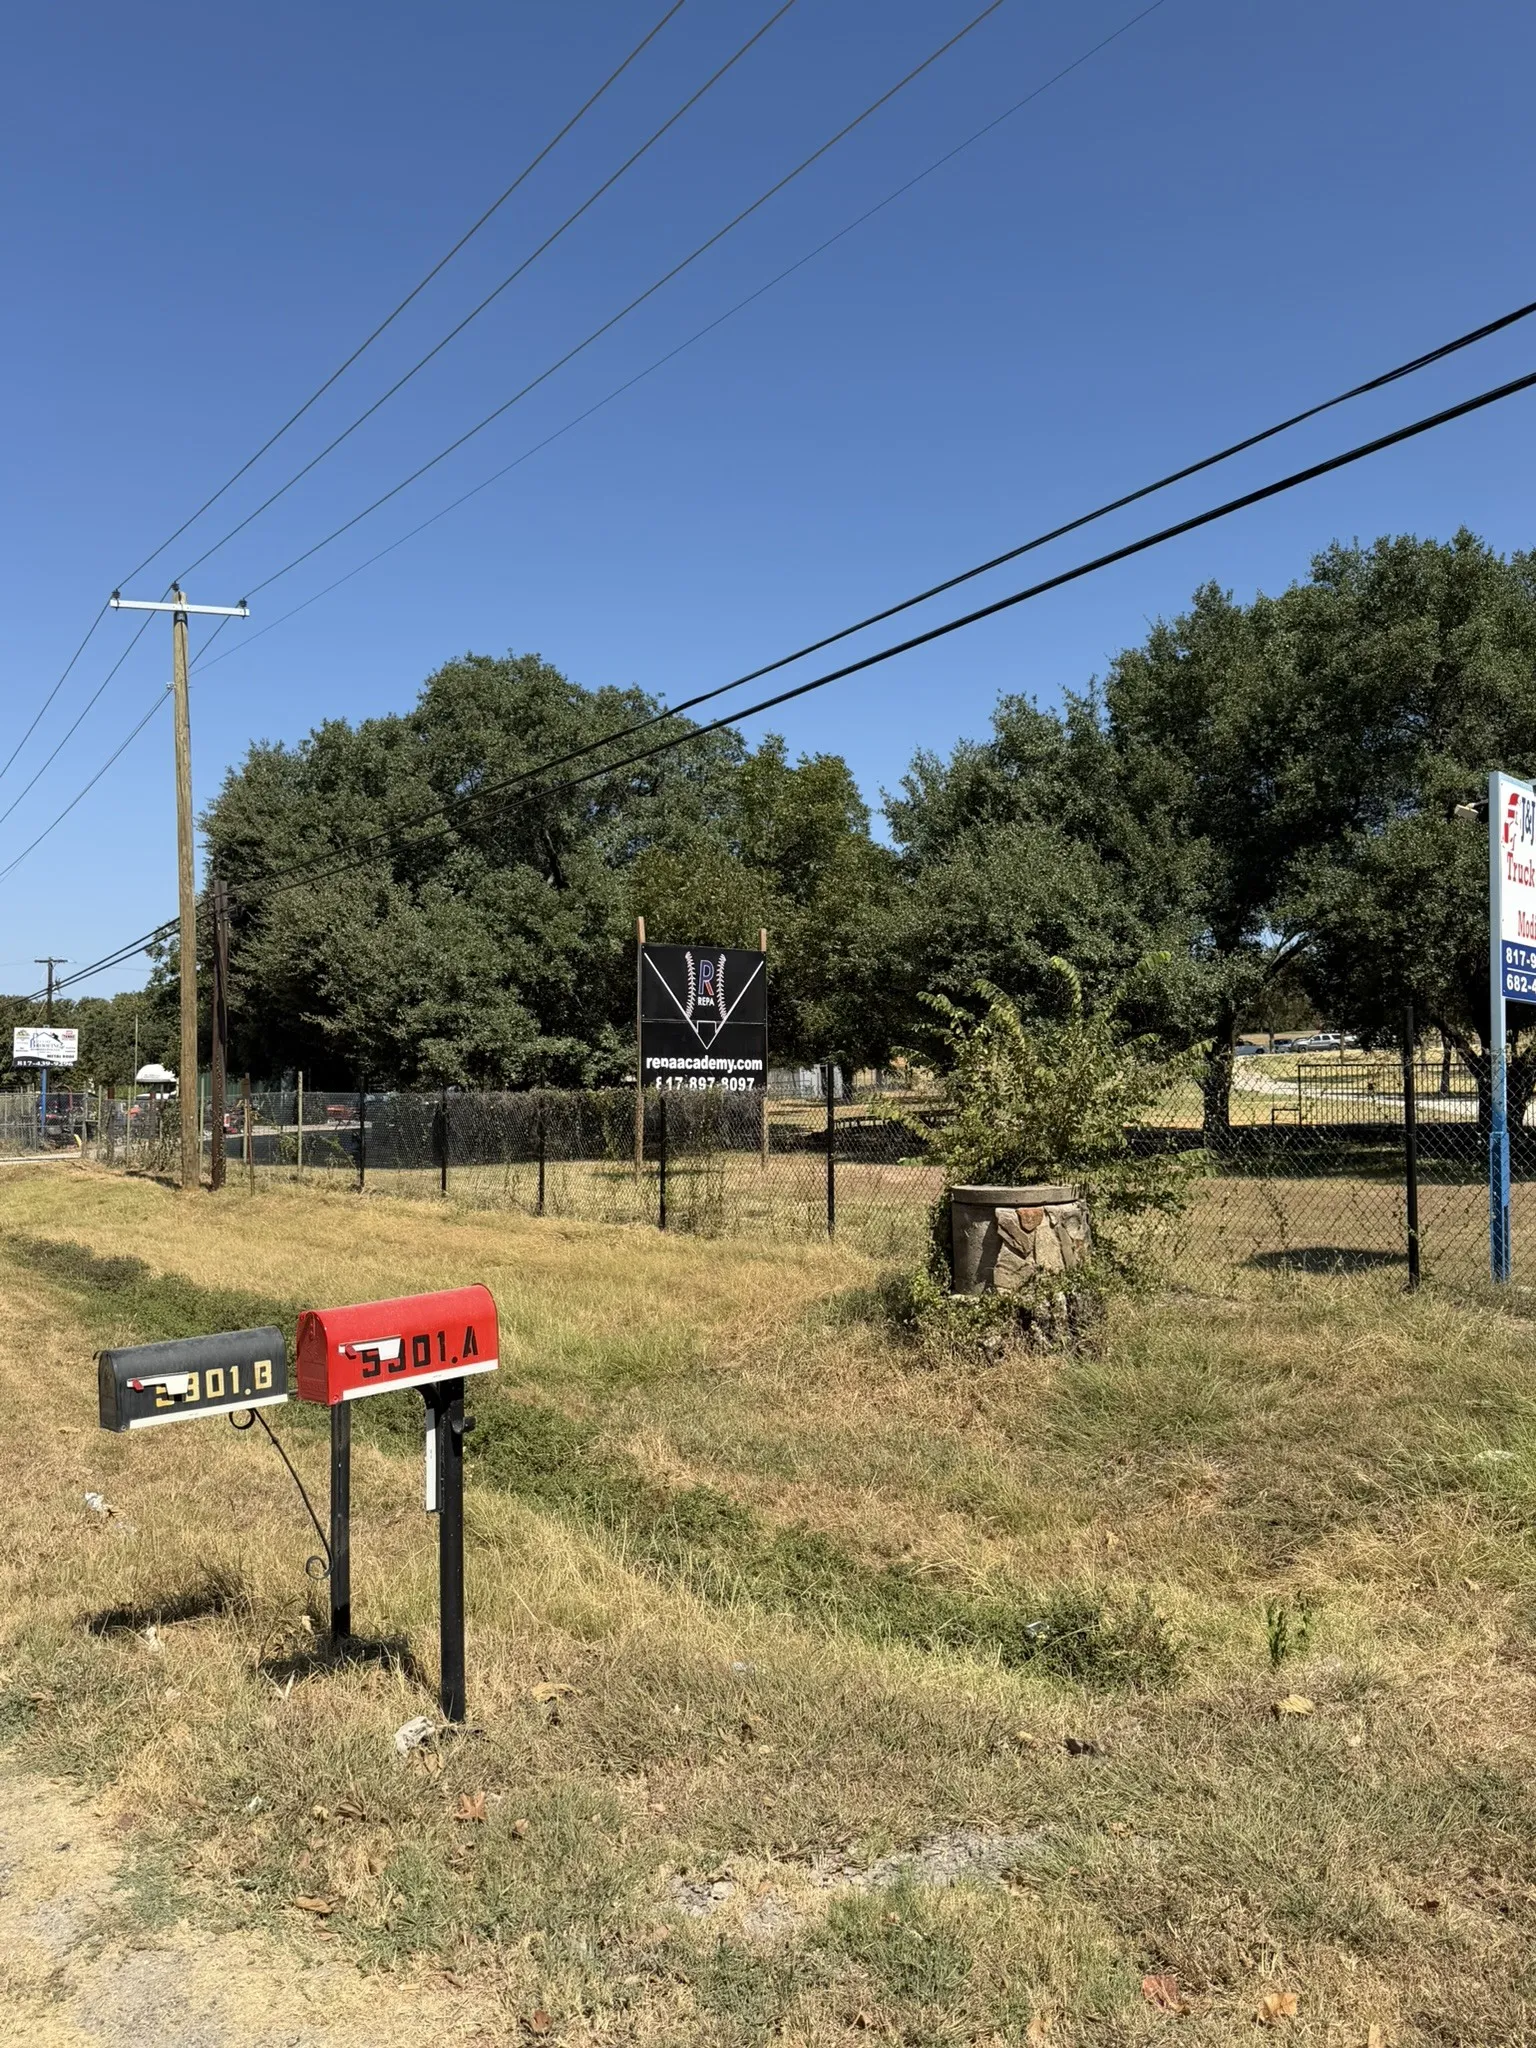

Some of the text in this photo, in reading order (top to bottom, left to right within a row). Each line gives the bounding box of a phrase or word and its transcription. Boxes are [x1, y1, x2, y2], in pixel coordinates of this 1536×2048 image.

[1507, 851, 1536, 887] Truck
[1506, 947, 1536, 968] 817-9
[698, 960, 714, 995] R
[698, 996, 715, 1006] REPA
